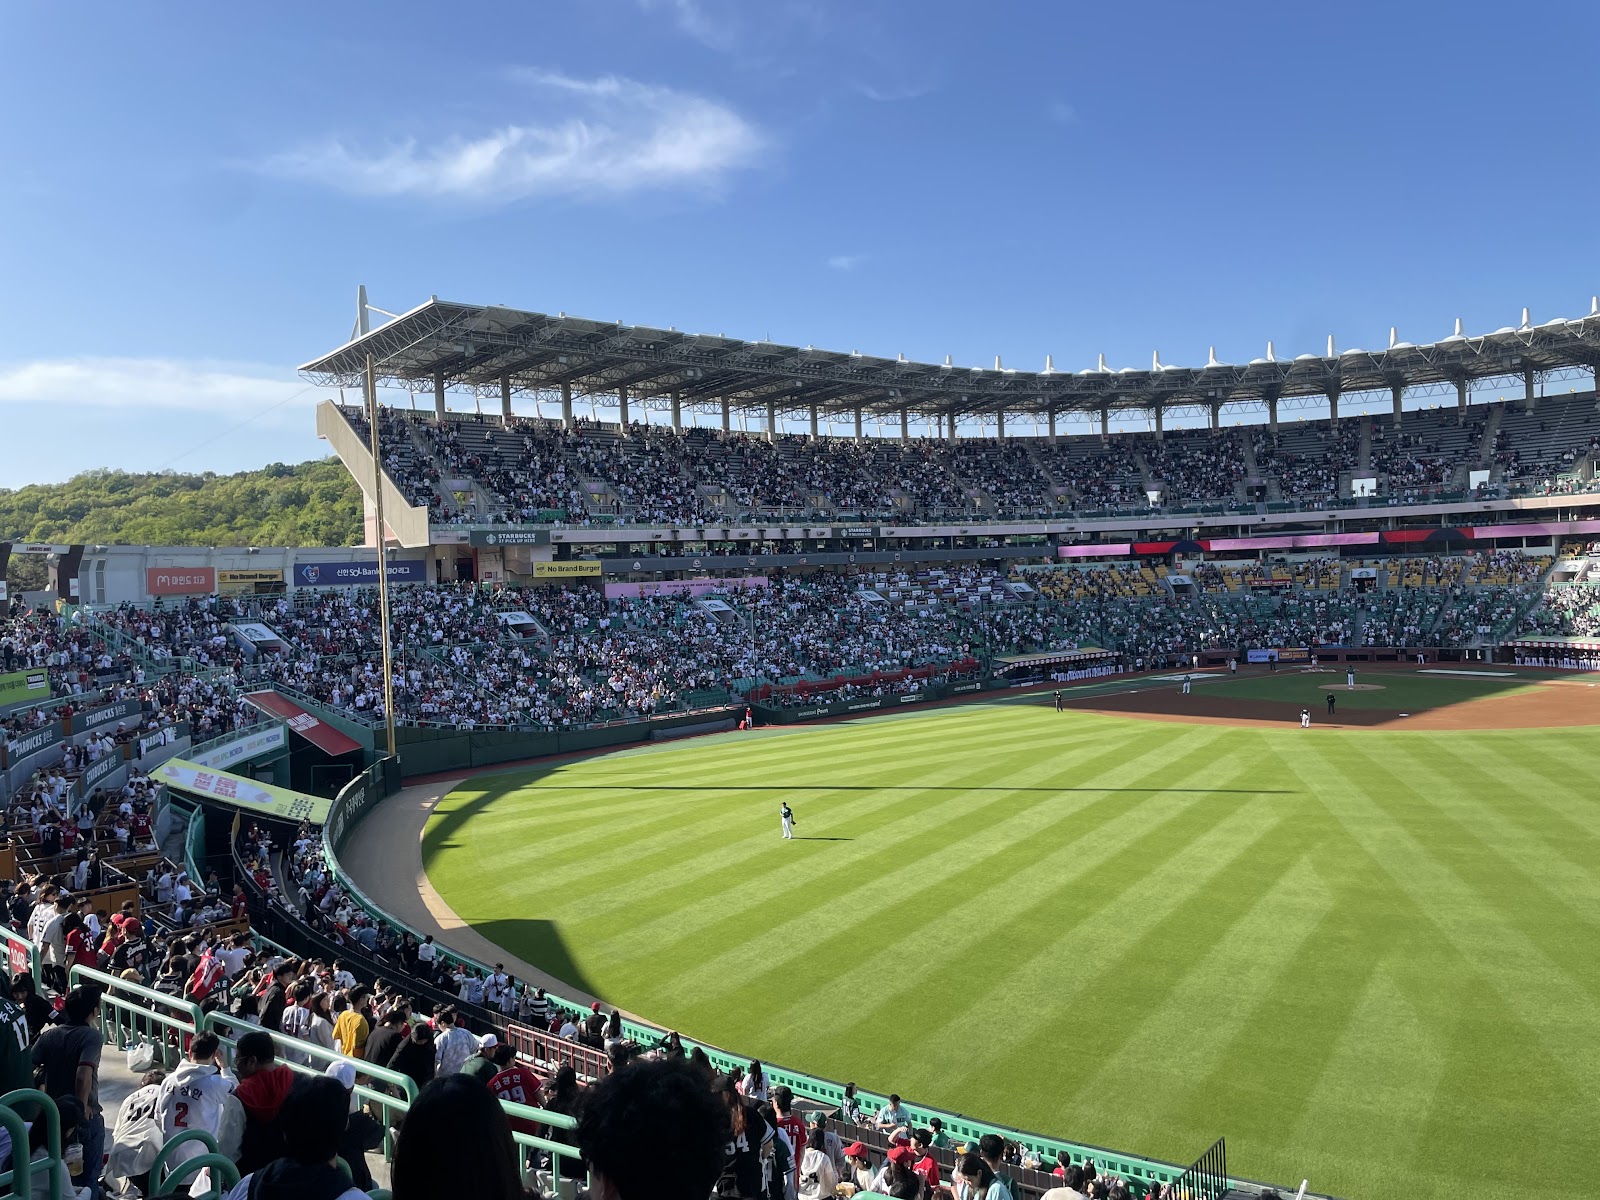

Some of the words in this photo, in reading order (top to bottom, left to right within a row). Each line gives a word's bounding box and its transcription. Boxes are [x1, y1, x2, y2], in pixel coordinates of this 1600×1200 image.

[258, 573, 279, 581] Burger
[578, 564, 600, 573] Burger
[172, 575, 192, 586] 마인드
[86, 706, 114, 727] STARBUCKS
[15, 733, 42, 758] STARBUCKS
[86, 761, 108, 785] STARBUCKS
[138, 819, 147, 827] 35
[12, 1014, 30, 1052] 17
[494, 1074, 520, 1090] 김광현
[174, 1102, 189, 1128] 2
